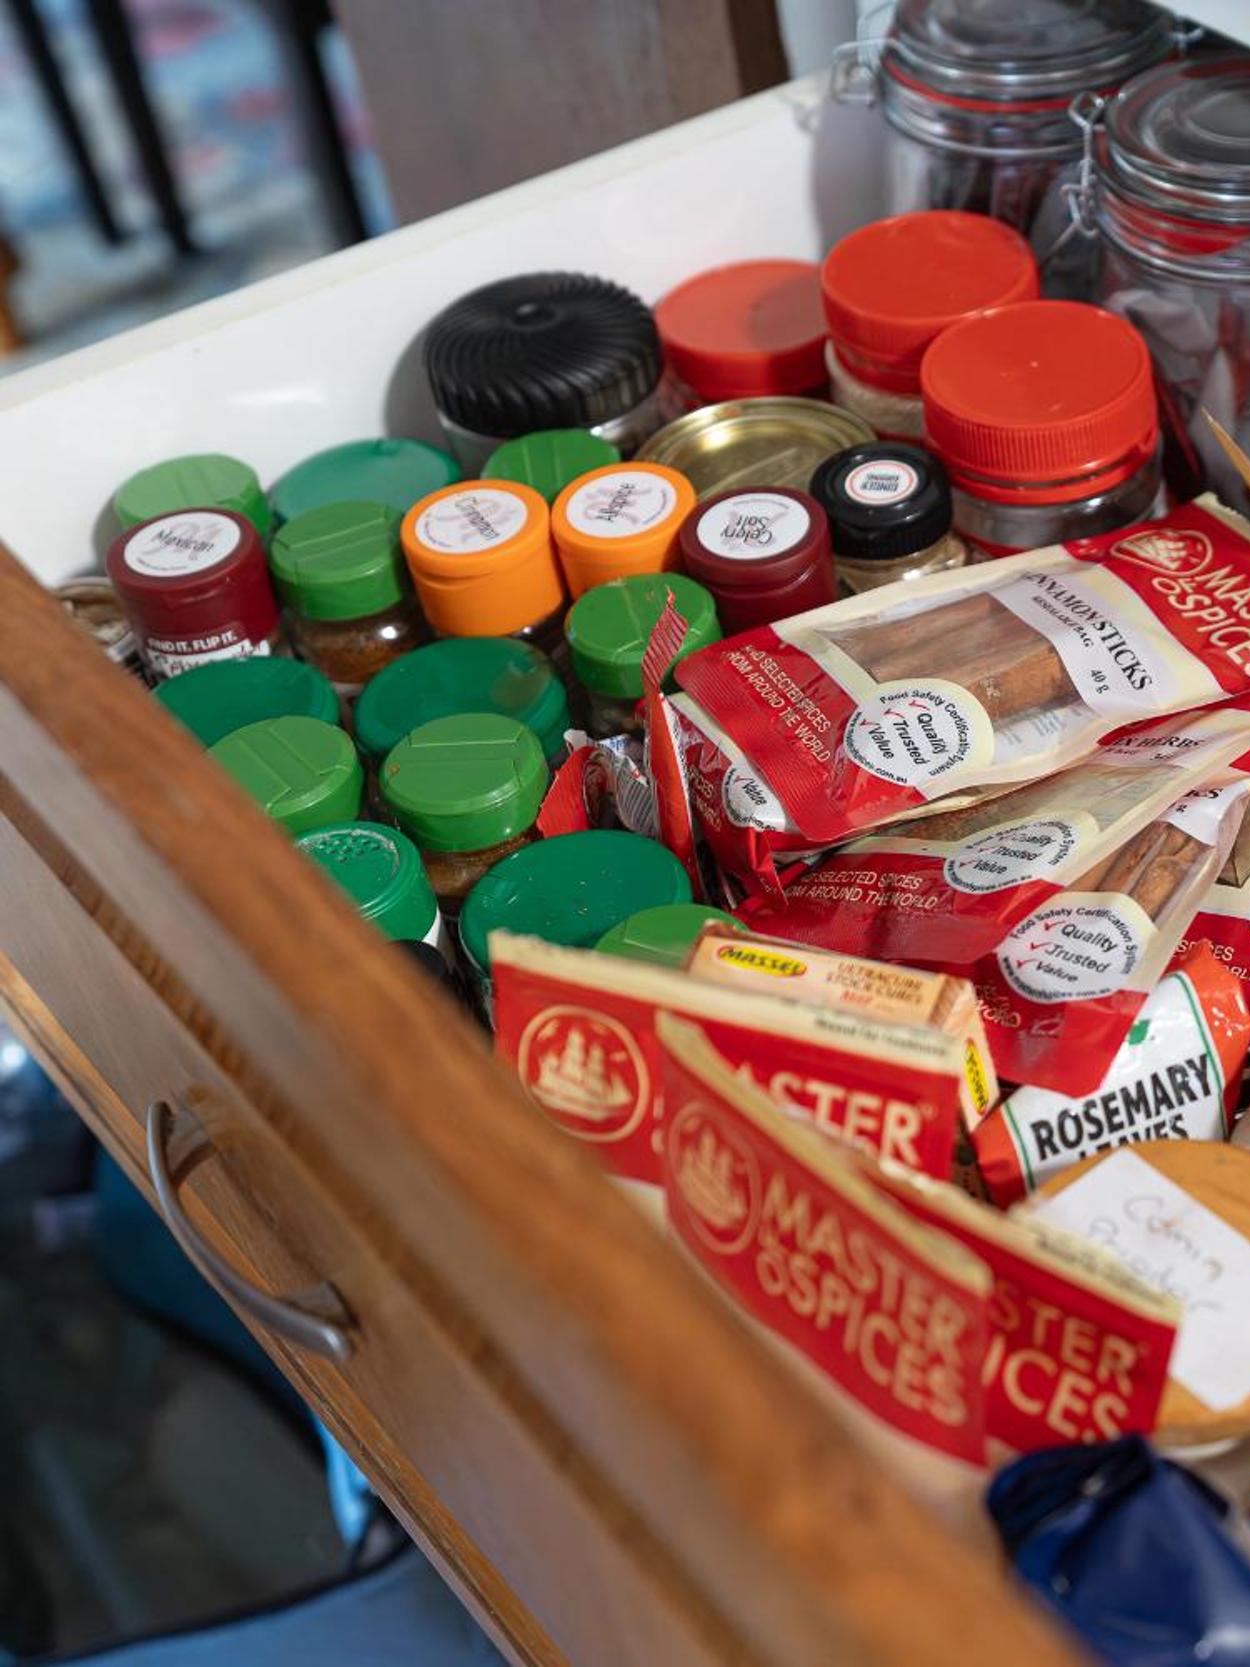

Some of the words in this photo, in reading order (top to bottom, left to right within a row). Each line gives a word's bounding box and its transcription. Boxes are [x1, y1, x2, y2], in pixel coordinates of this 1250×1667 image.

[720, 524, 774, 545] Celery
[736, 514, 771, 531] Salt
[157, 528, 215, 553] Mexican
[1093, 617, 1153, 691] STICKS
[746, 672, 785, 708] AROUND
[794, 723, 832, 762] WORLD
[868, 723, 895, 760] Value
[893, 719, 930, 766] Trusted
[917, 712, 948, 756] Quality
[806, 886, 863, 901] AROUND
[815, 871, 878, 885] SELECTED
[1010, 918, 1036, 939] Food
[1035, 907, 1073, 921] Safety
[1076, 906, 1133, 943] Certification
[1061, 923, 1118, 952] Quality
[1035, 961, 1079, 983] Value
[1045, 944, 1111, 974] Trusted
[1030, 1053, 1212, 1161] ROSEMARY
[760, 1174, 970, 1367] MASTER
